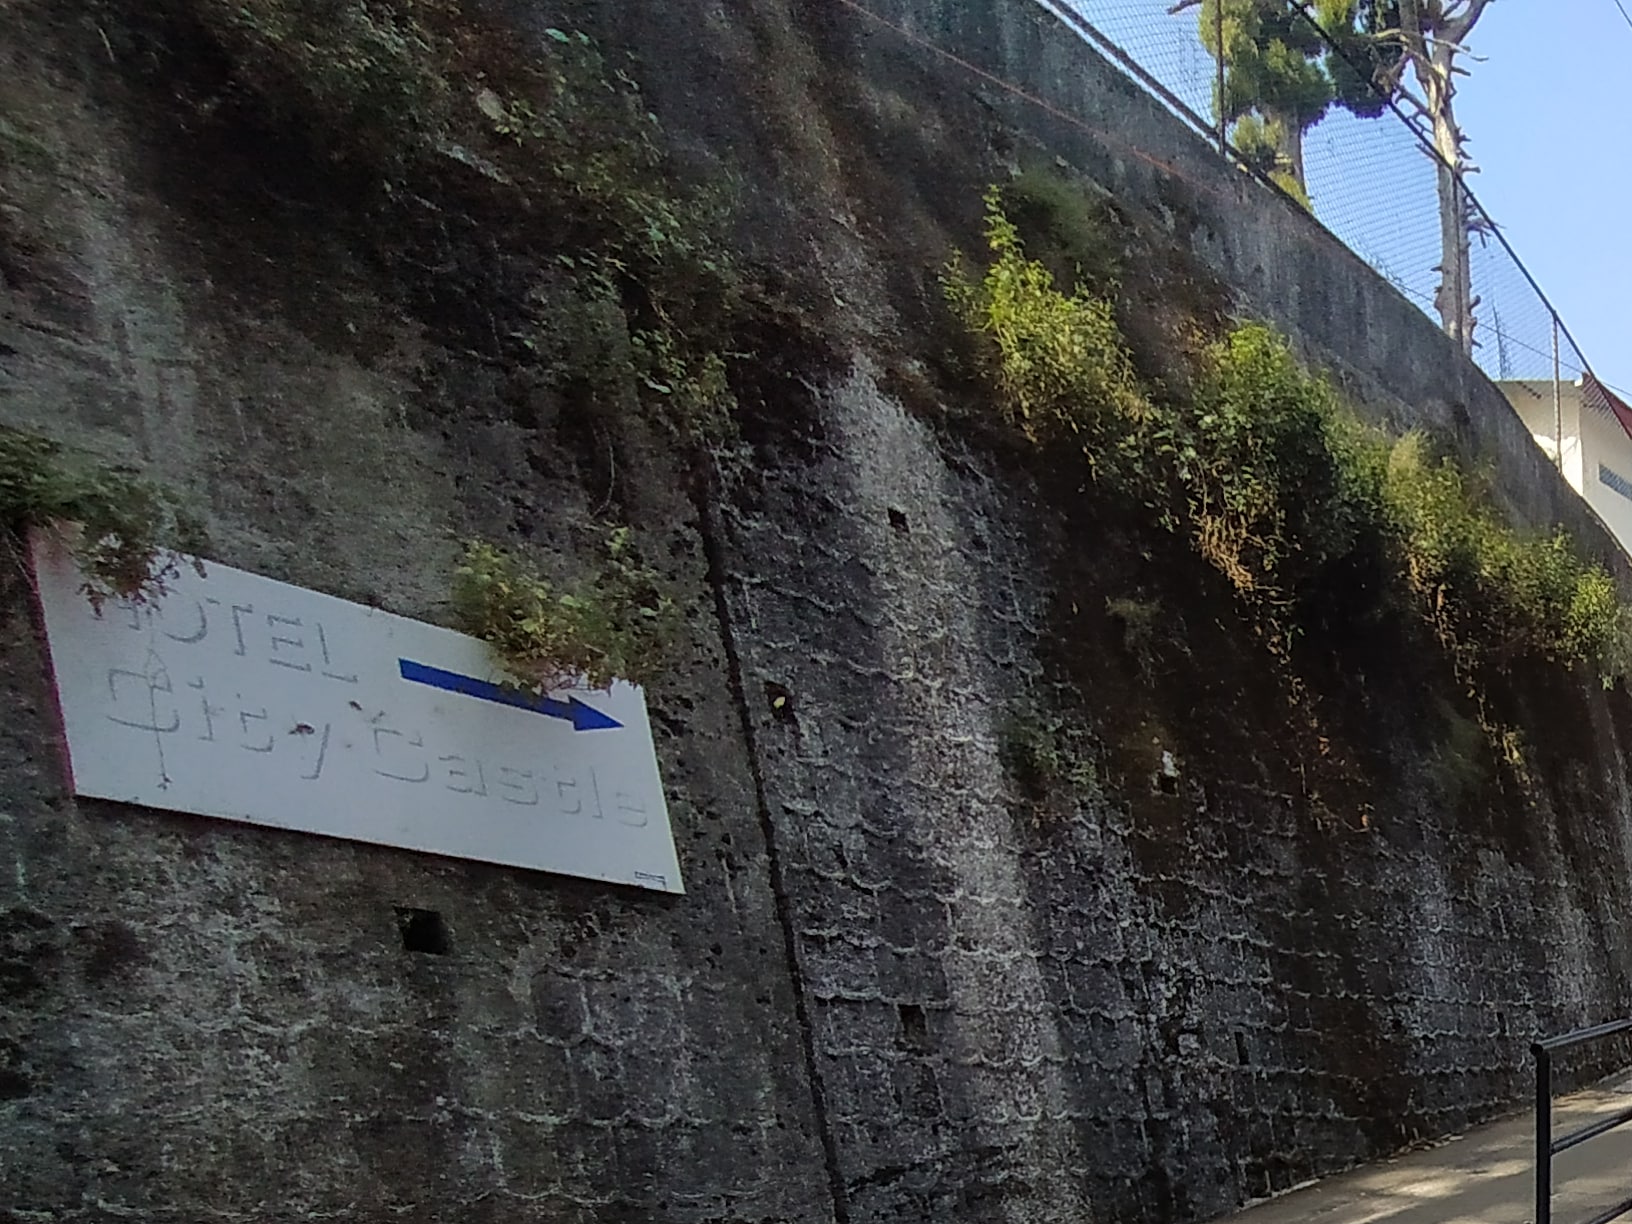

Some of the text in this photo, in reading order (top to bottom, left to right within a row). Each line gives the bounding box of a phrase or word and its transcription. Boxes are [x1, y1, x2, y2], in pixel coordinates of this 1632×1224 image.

[120, 588, 358, 684] OTEL
[106, 664, 649, 828] City Castle
